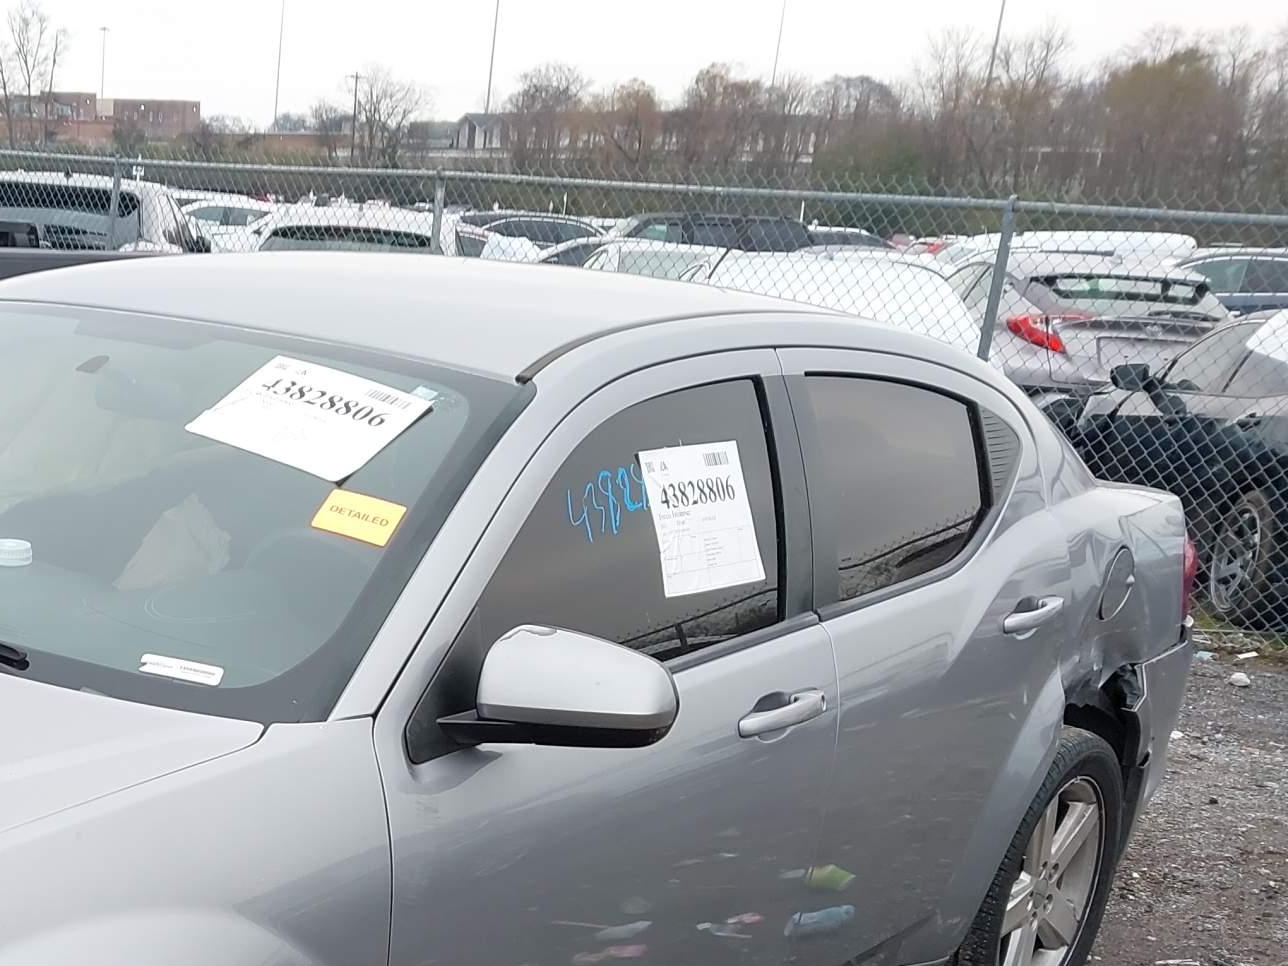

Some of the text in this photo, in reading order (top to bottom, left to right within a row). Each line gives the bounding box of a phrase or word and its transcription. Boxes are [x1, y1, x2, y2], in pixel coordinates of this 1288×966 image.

[262, 378, 391, 427] 43828806
[660, 475, 736, 510] 43828806
[329, 504, 390, 527] DETAILED
